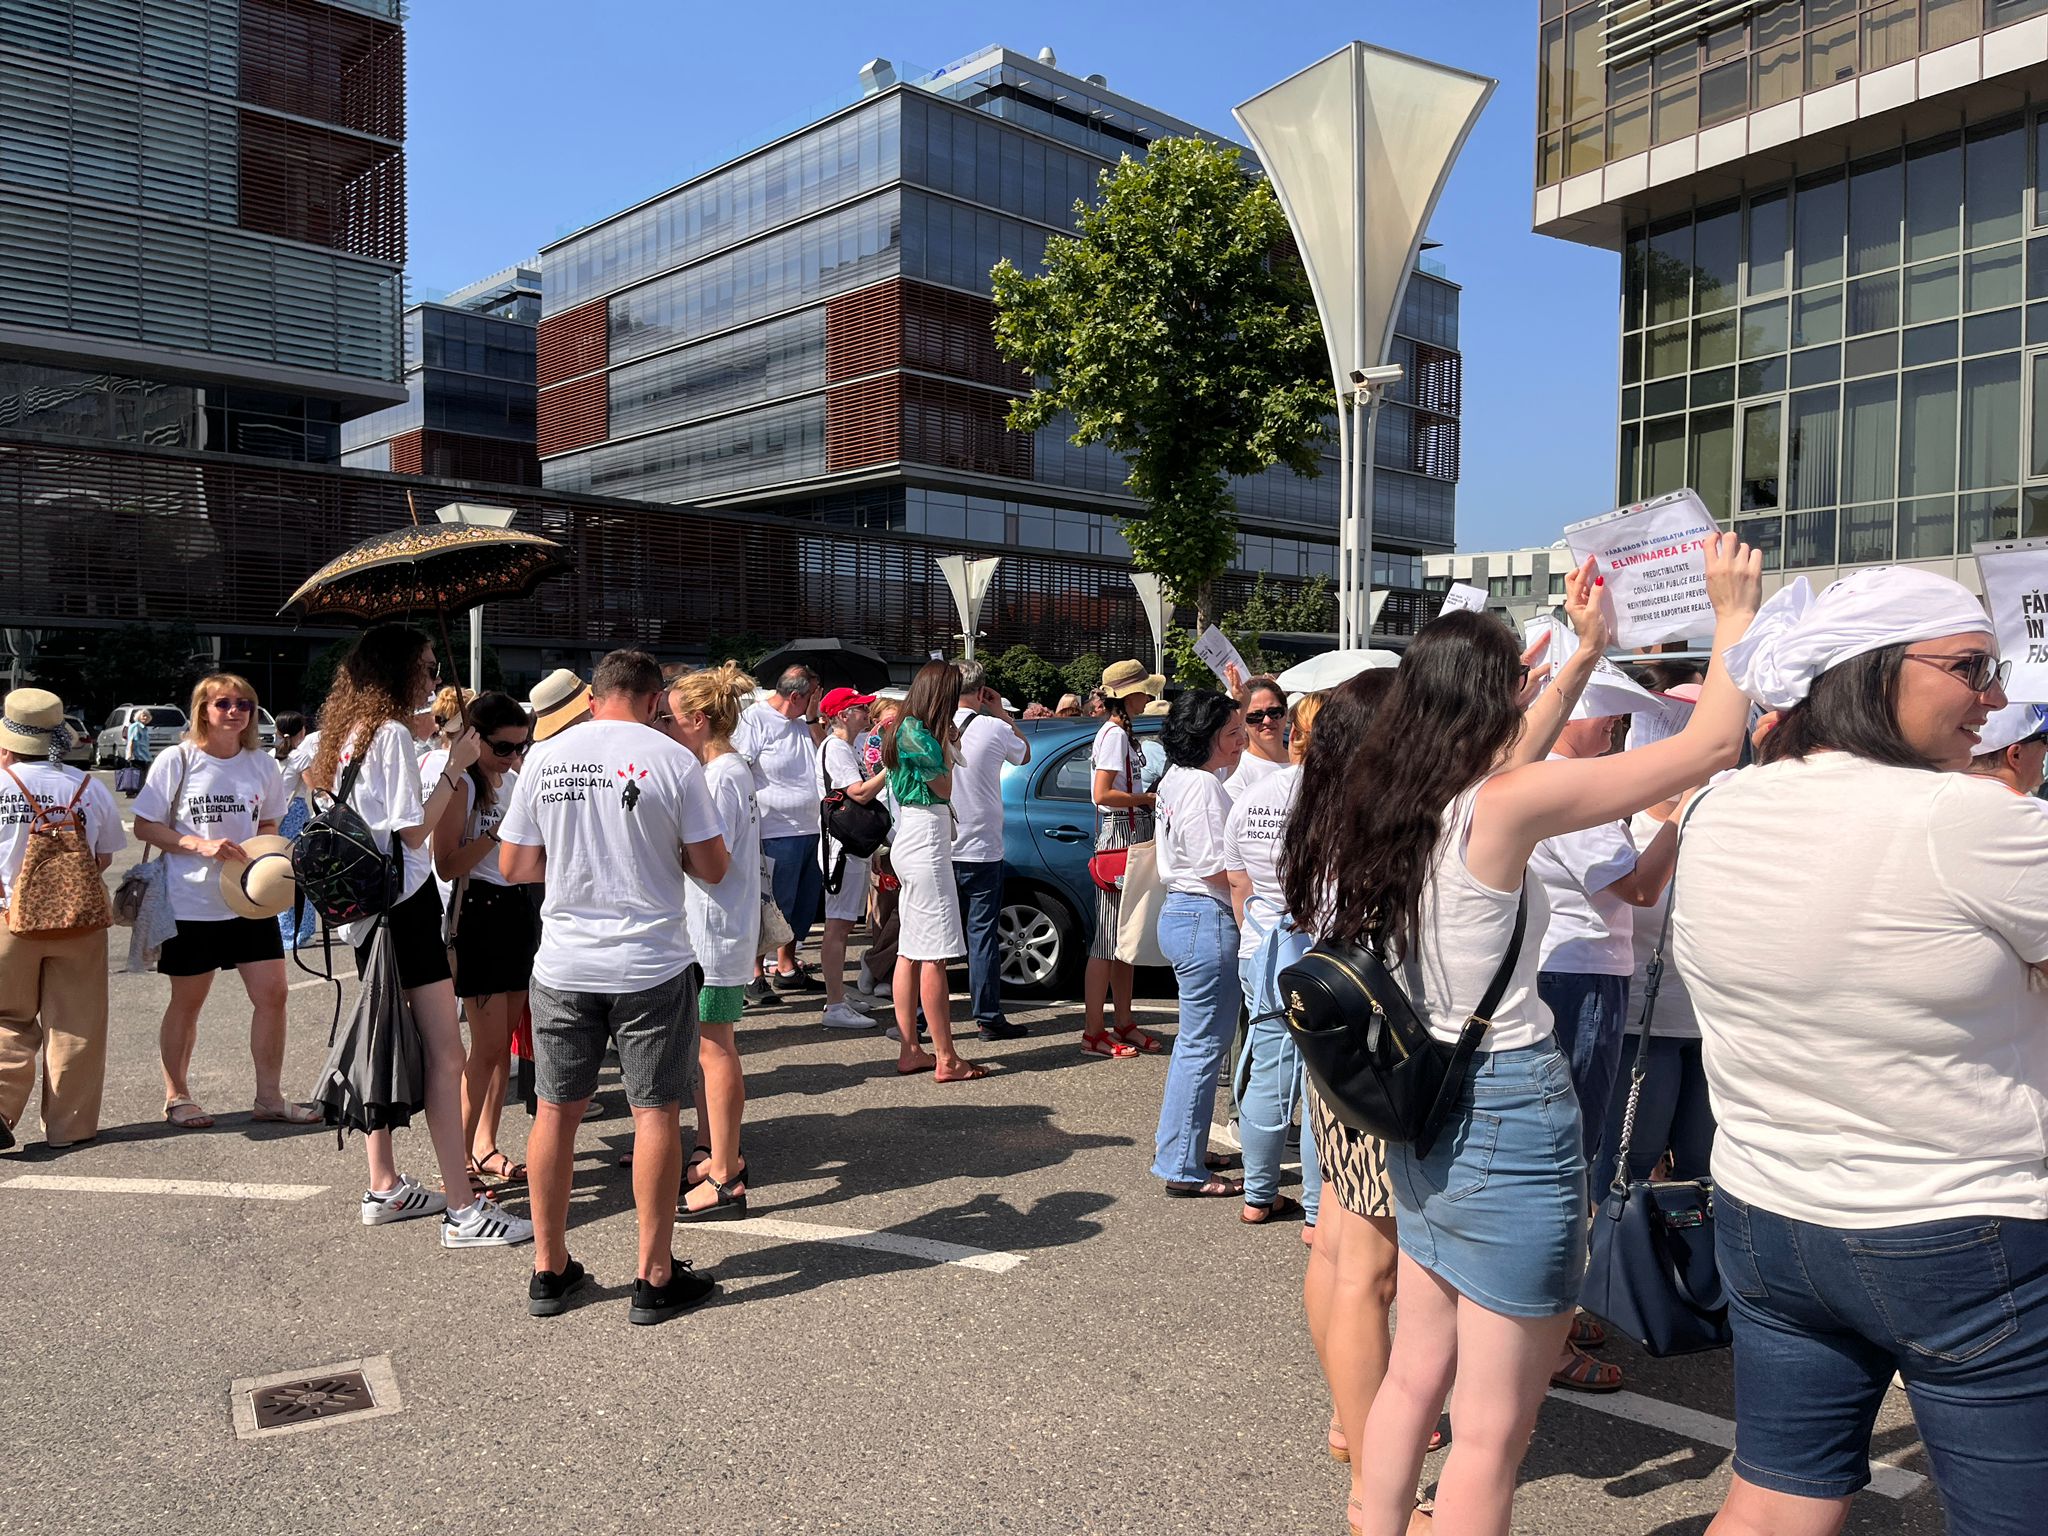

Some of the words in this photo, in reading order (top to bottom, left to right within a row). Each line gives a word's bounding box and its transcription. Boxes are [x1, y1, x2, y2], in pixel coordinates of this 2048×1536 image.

[1622, 543, 1640, 551] HAOS
[1611, 546, 1678, 570] ELIMINAREA
[1681, 540, 1705, 552] E-TV
[1643, 563, 1689, 579] PREDICTIBILITATE
[1666, 577, 1688, 589] PUBLICE
[1689, 573, 1706, 583] REALE
[1627, 595, 1670, 610] REINTRODUCEREA
[1671, 592, 1685, 602] LEGII
[1686, 588, 1707, 598] PREVEN
[1631, 611, 1653, 623] TERMENE
[1654, 610, 1661, 619] DE
[1661, 605, 1690, 618] RAPORTARE
[1691, 601, 1711, 612] REALIS
[2024, 615, 2045, 638] ÎN
[542, 763, 567, 777] FĂRĂ
[572, 764, 603, 773] HAOS
[542, 780, 551, 790] ÎN
[554, 777, 613, 790] LEGISLAȚIA
[213, 795, 234, 803] HAOS
[542, 789, 585, 804] FISCALĂ
[1248, 806, 1270, 815] FĂRĂ
[1248, 817, 1255, 827] ÎN
